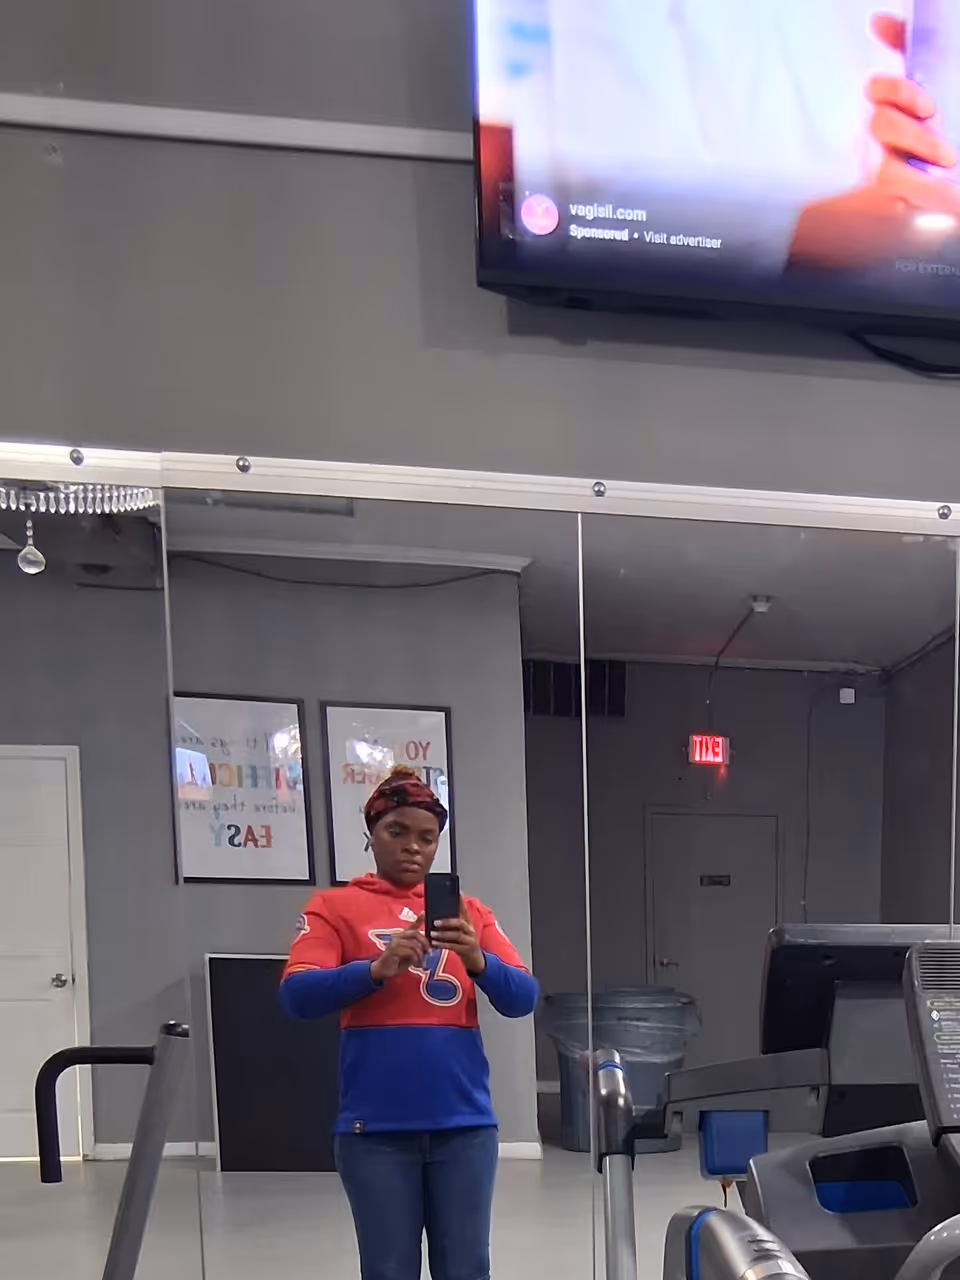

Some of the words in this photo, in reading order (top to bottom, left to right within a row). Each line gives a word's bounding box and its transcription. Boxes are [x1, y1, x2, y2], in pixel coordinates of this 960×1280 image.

[569, 203, 646, 222] vagisil.com
[569, 223, 629, 242] Sponsored
[643, 231, 668, 245] Visit
[669, 233, 723, 249] advertiser
